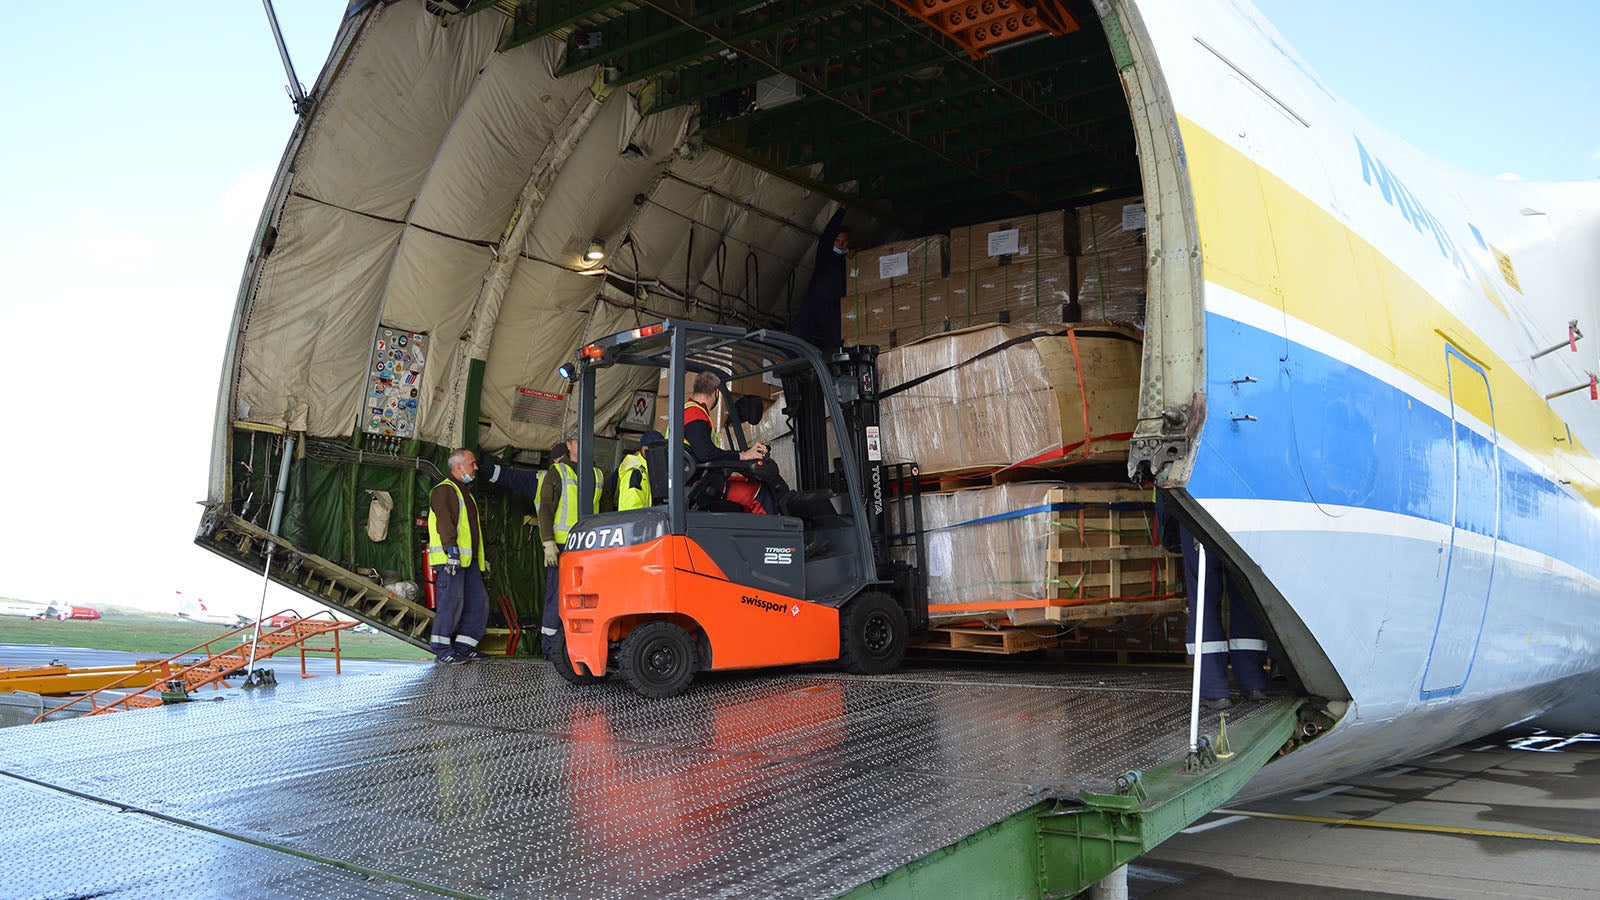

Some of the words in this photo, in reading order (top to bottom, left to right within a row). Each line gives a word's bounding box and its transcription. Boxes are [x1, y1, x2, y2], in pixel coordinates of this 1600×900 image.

[871, 464, 883, 515] TOYOTA
[764, 553, 792, 565] 25
[740, 595, 788, 613] swissport
